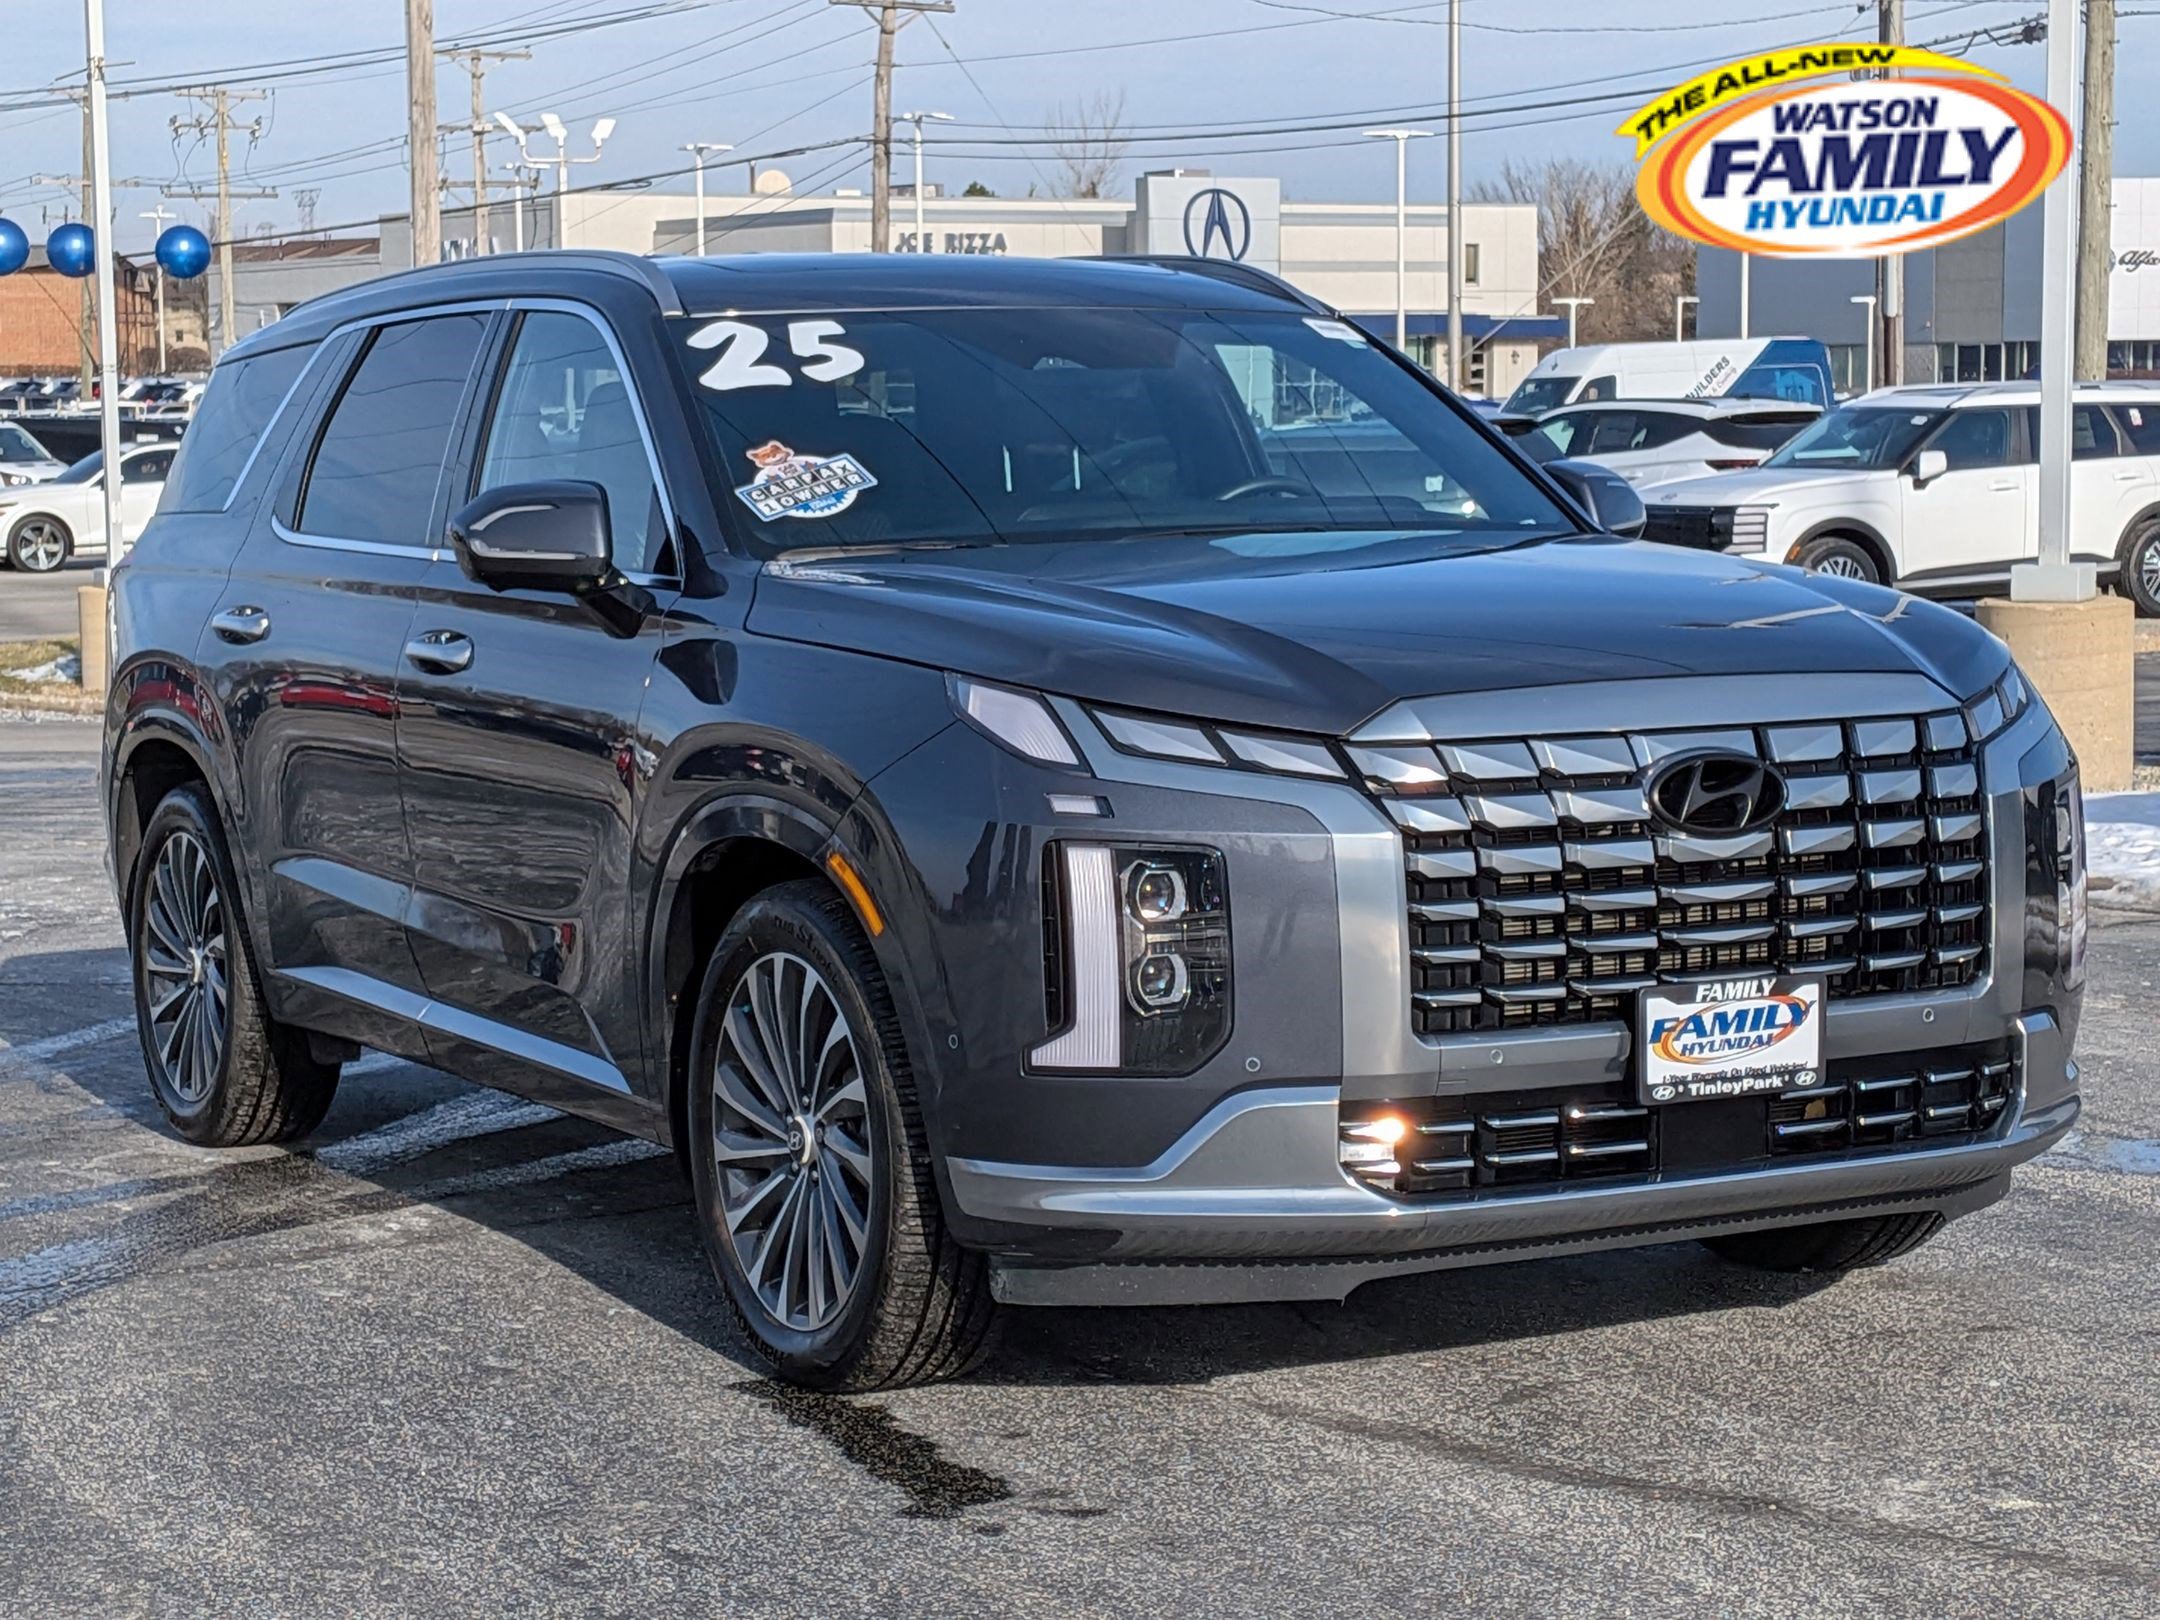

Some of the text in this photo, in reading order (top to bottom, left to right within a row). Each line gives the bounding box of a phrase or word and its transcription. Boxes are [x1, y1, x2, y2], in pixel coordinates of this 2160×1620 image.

[895, 232, 1007, 256] JOE RIZZA
[686, 320, 865, 391] 25
[750, 463, 852, 501] CARFAX
[780, 473, 863, 507] OWNER
[1695, 977, 1777, 1002] FAMILY
[1648, 1000, 1817, 1044] FAMILY
[1680, 1033, 1774, 1057] HYUNDAI
[1688, 1075, 1783, 1096] TinleyPark
